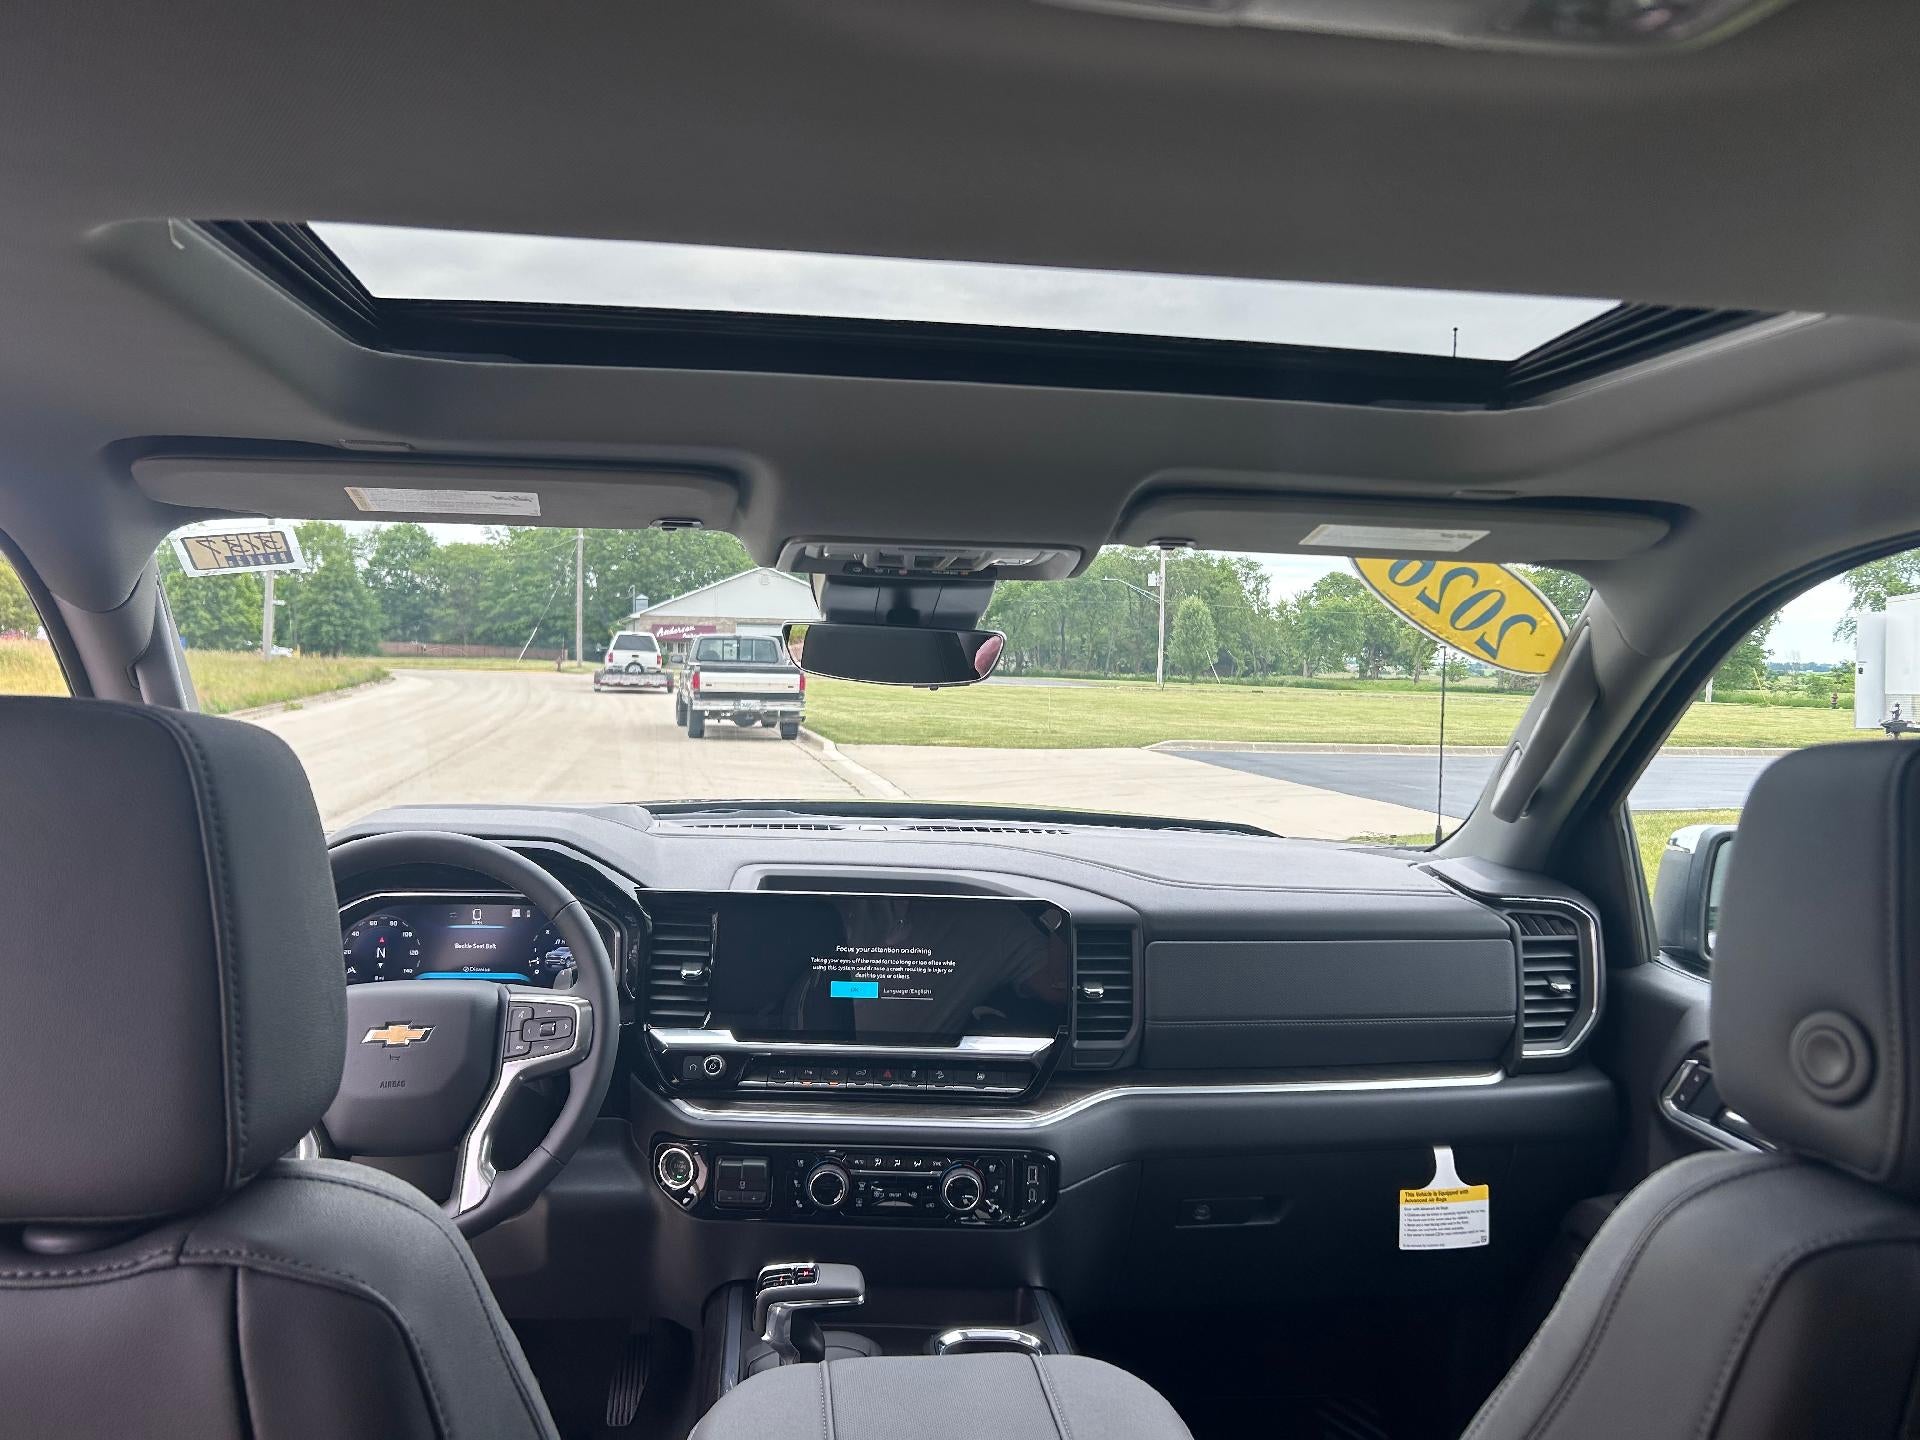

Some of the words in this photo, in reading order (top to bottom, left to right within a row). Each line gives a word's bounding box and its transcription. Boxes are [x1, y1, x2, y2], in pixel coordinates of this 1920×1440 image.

[376, 947, 386, 958] N
[870, 946, 900, 954] attention
[909, 947, 932, 956] driving
[379, 1080, 406, 1089] AIRBAG
